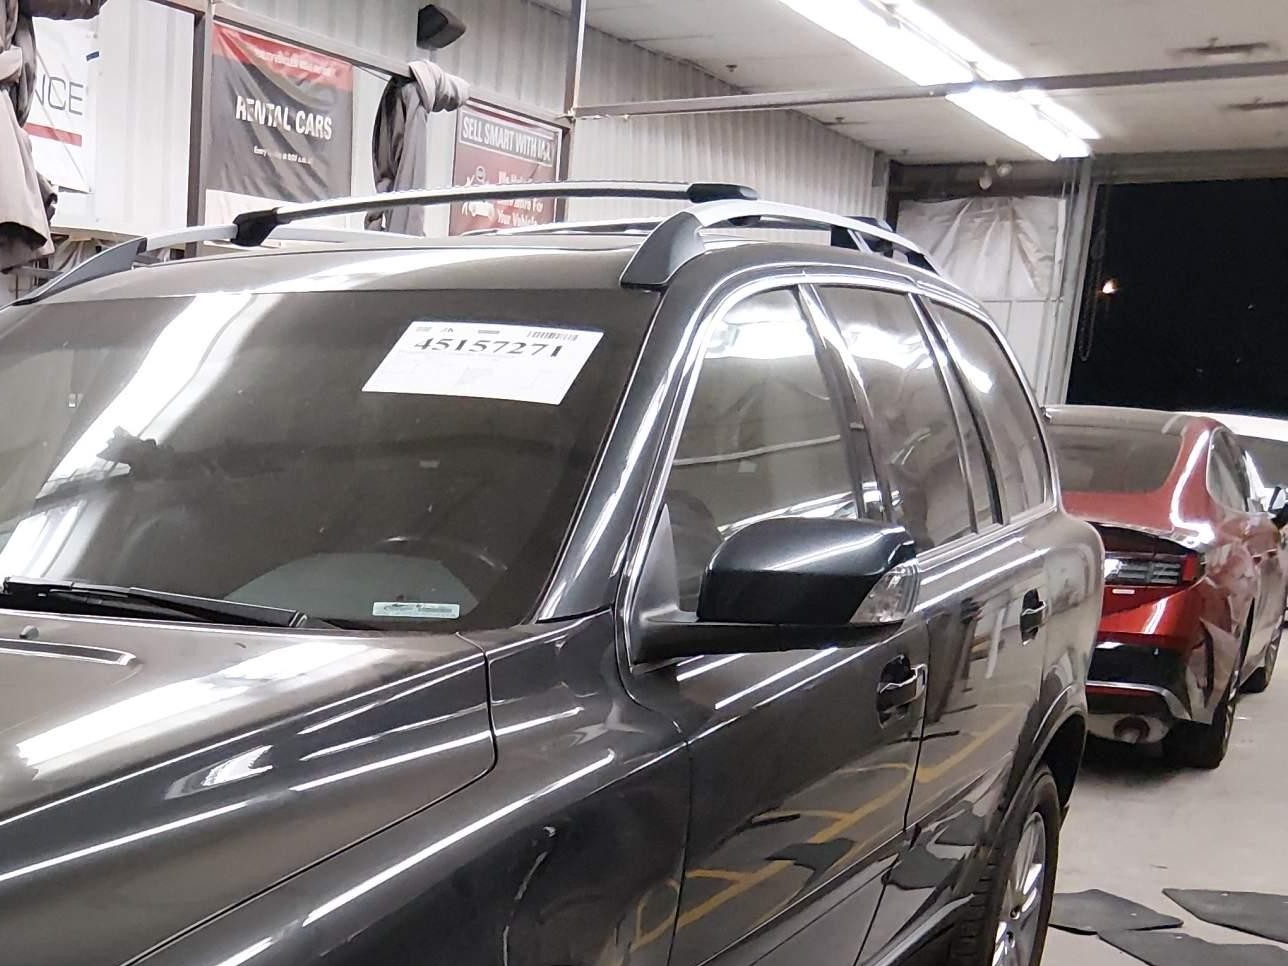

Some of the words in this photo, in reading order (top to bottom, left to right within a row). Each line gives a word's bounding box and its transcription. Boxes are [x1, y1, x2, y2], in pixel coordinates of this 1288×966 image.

[235, 95, 292, 132] RENTAL
[295, 110, 333, 140] CARS
[462, 116, 483, 143] SELL
[484, 122, 514, 151] SMART
[515, 131, 537, 157] WITH
[413, 337, 563, 358] 45157271
